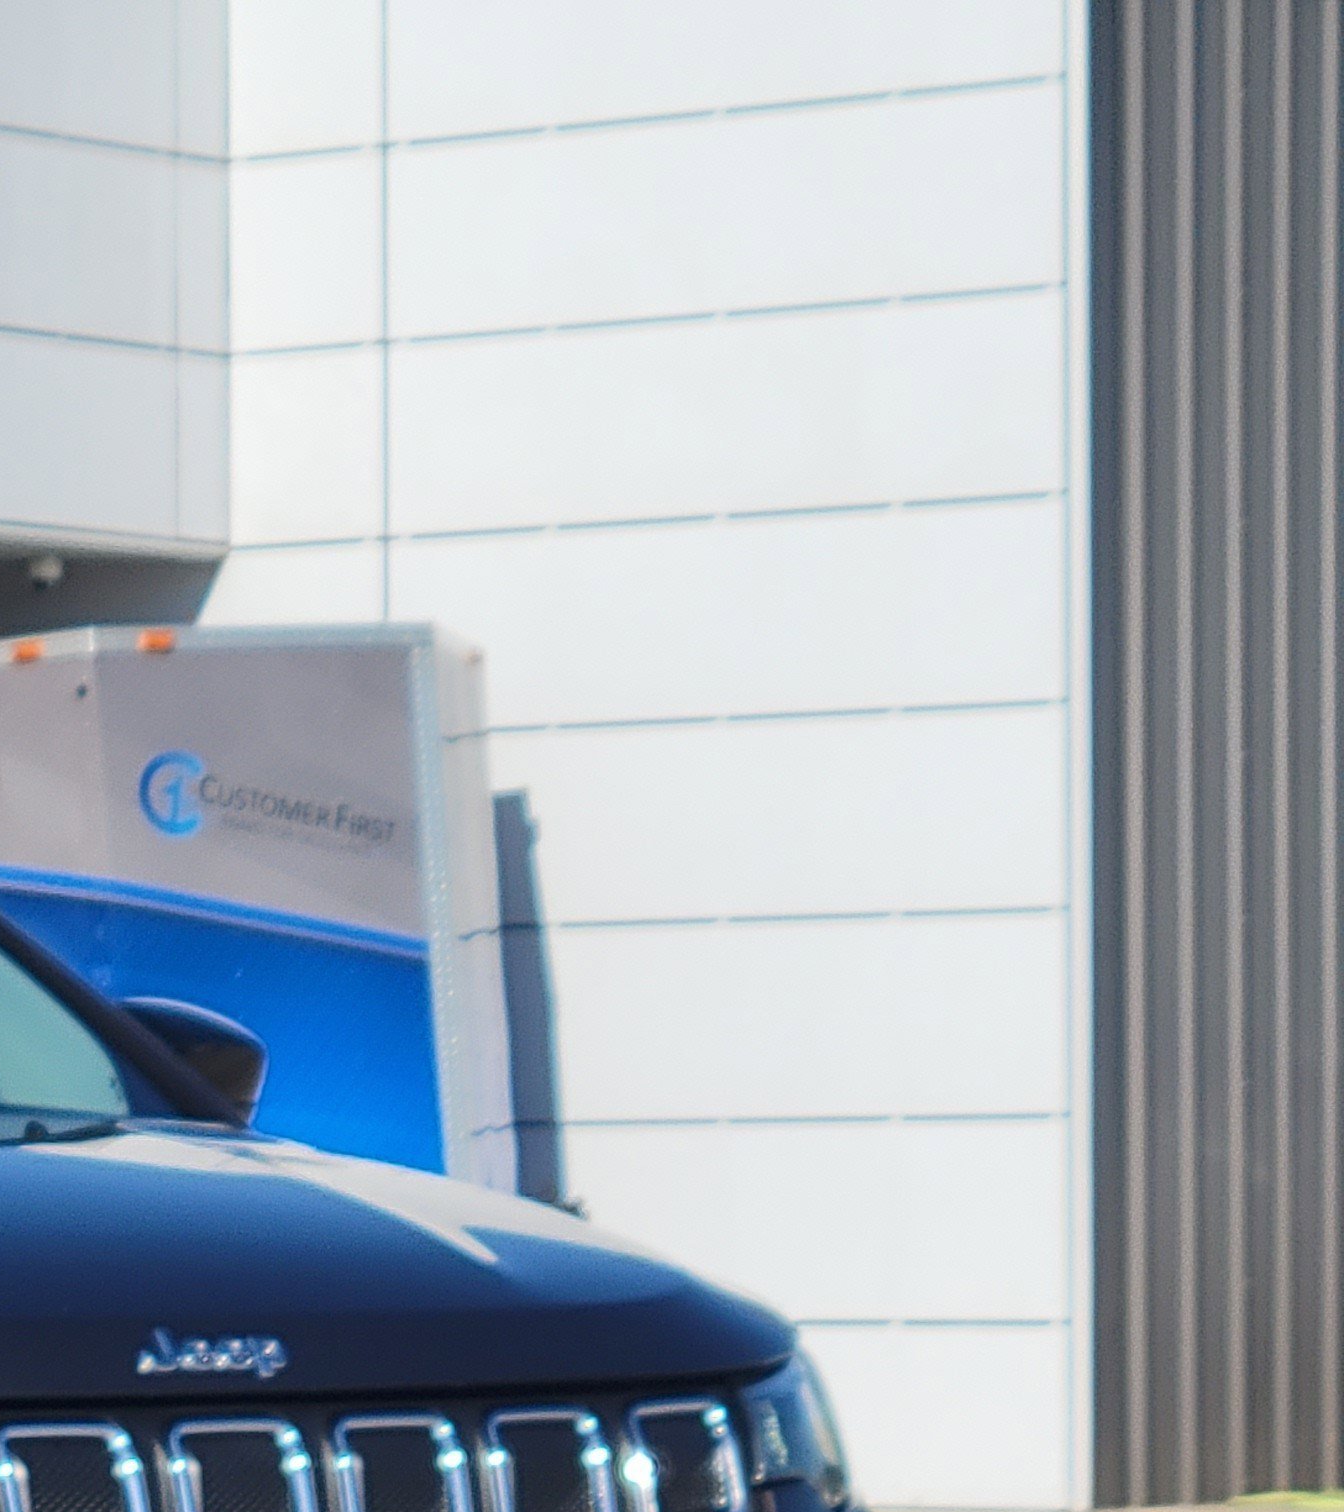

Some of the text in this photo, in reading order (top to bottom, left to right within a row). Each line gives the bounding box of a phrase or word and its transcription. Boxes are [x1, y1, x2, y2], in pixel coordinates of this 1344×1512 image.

[198, 774, 330, 829] CUSTOMER
[333, 803, 396, 842] FIRST
[136, 1327, 288, 1378] Jeep
